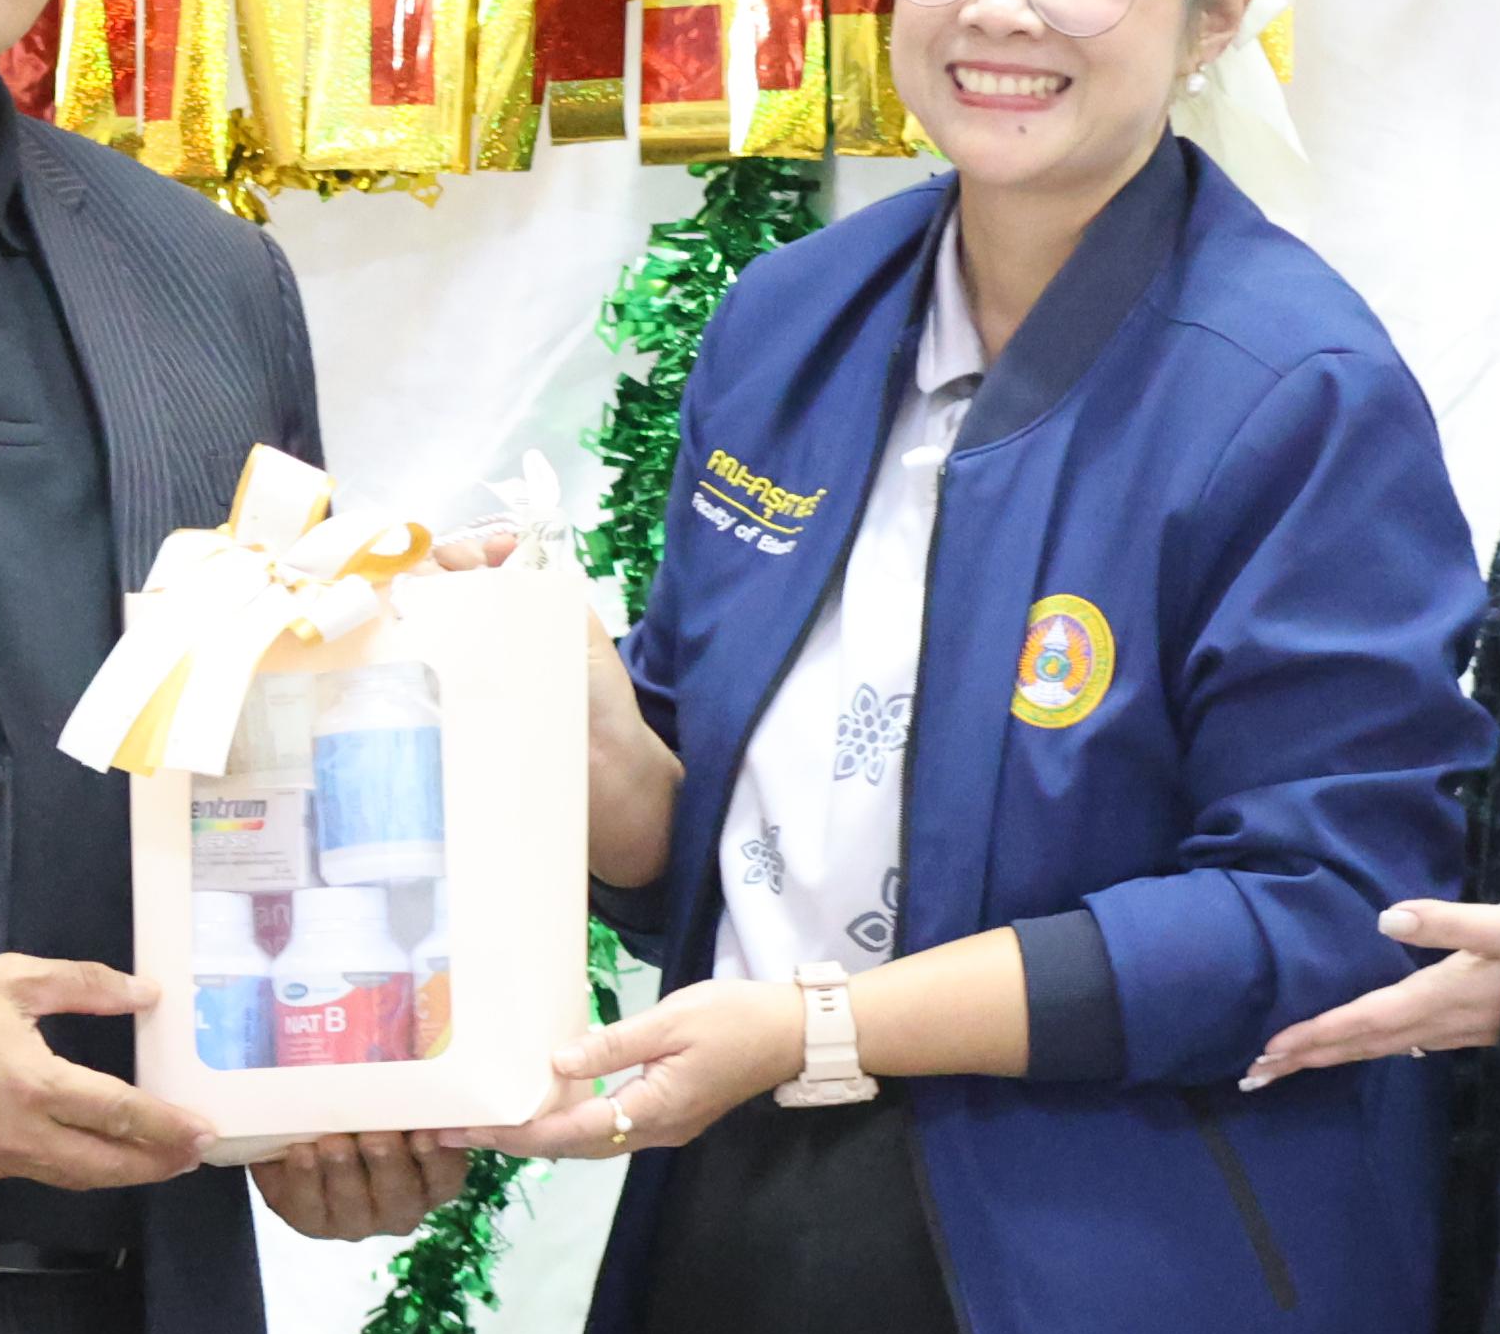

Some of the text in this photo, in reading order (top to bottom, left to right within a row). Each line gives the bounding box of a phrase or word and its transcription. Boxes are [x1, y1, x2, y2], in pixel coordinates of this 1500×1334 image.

[191, 797, 267, 818] entrum
[283, 1006, 347, 1034] NAT B
